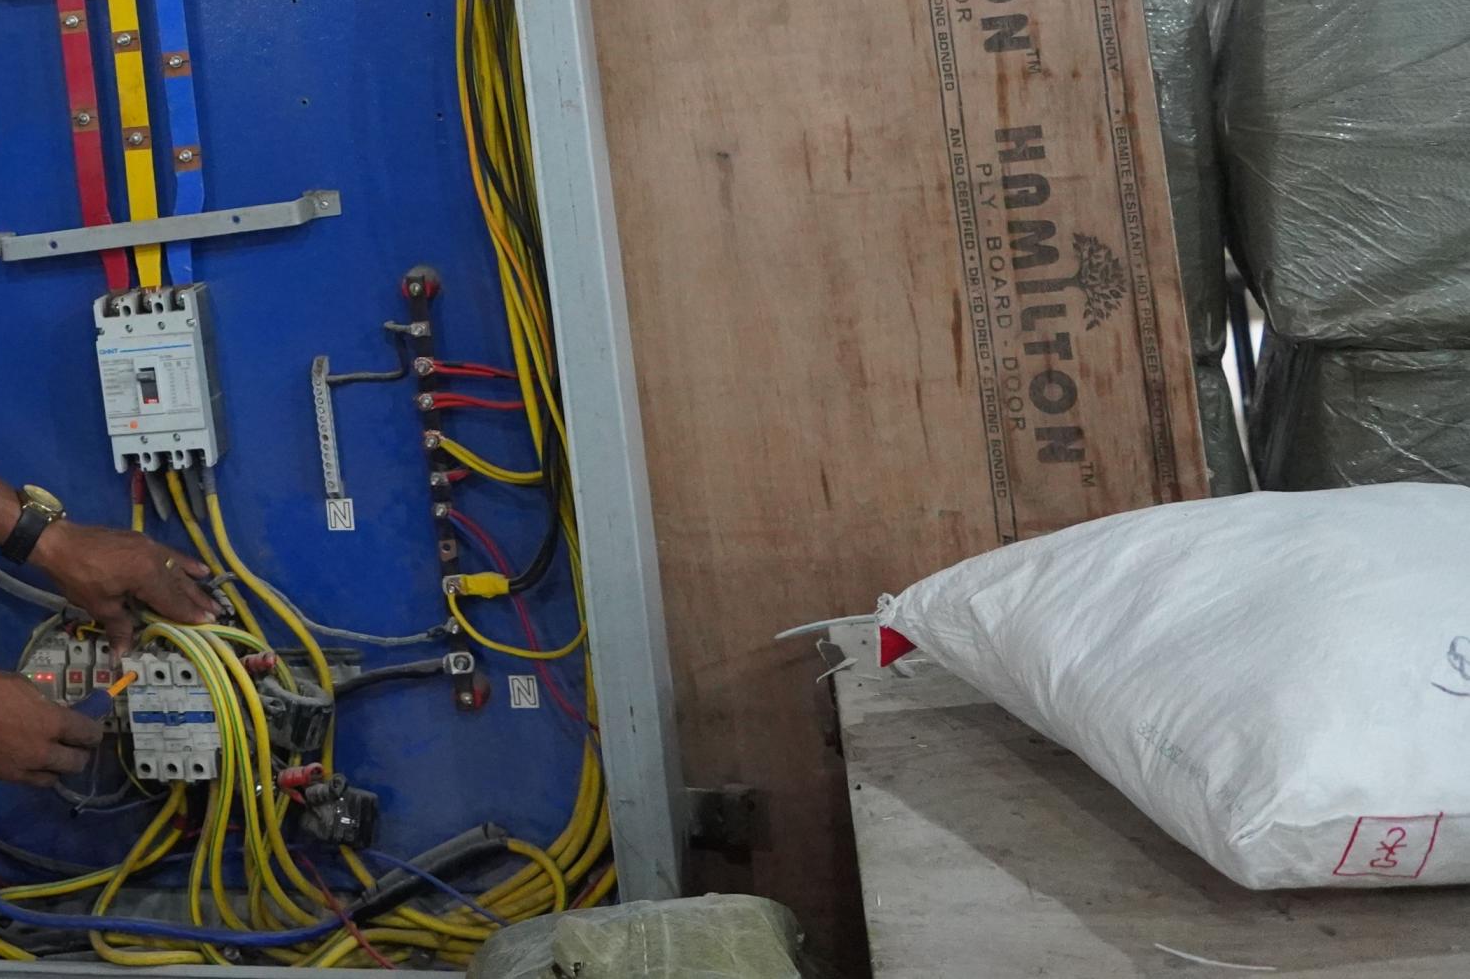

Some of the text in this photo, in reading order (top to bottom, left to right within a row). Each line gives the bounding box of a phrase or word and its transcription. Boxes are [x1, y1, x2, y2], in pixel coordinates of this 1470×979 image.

[938, 34, 955, 92] BONDED
[1027, 49, 1041, 75] TM
[1101, 5, 1119, 73] FRIENDLY
[950, 127, 960, 146] AN
[952, 153, 964, 176] ISO
[1112, 120, 1130, 186] ERMITE
[957, 179, 975, 250] CERTIFIED
[976, 162, 1027, 431] PLY BOARD DOOR
[994, 125, 1095, 488] HAMILTON TM
[974, 315, 989, 359] DRIED
[990, 439, 1008, 499] BONDED
[329, 503, 353, 528] N
[512, 680, 537, 706] N
